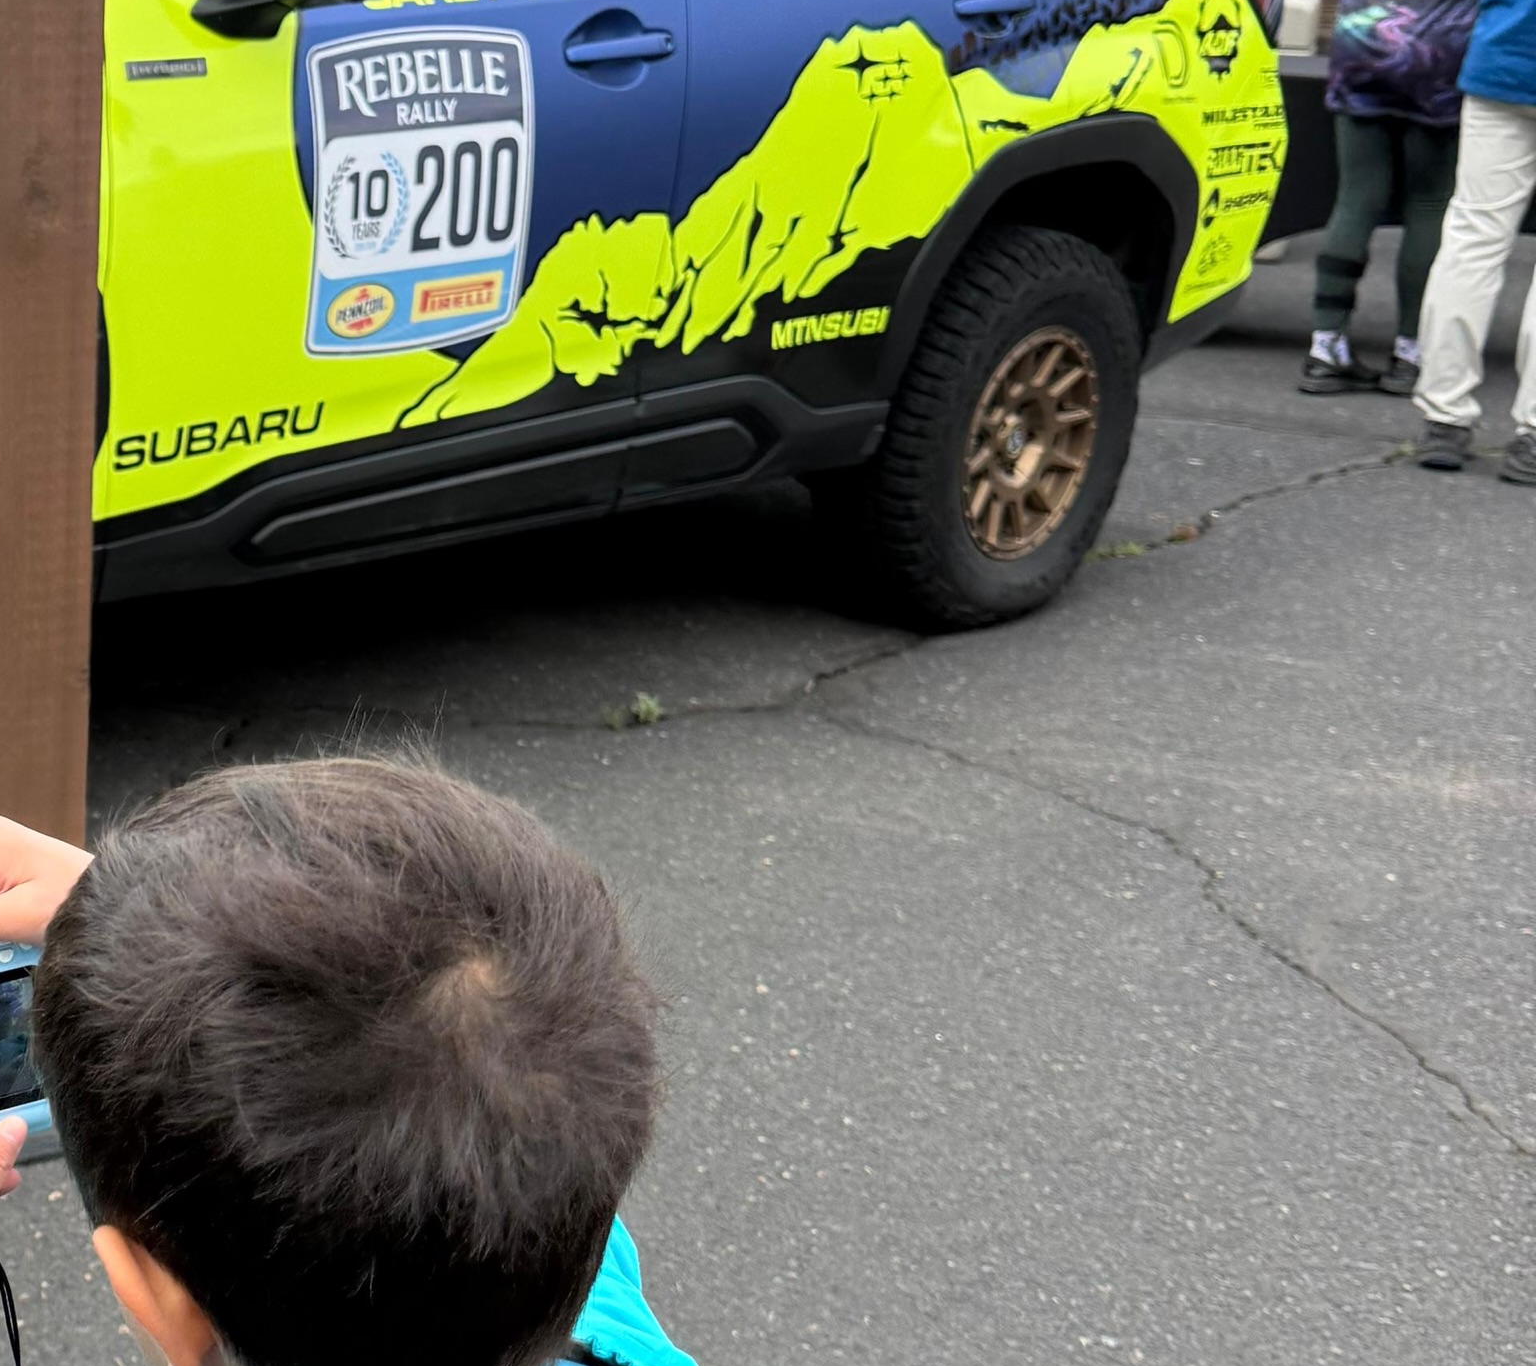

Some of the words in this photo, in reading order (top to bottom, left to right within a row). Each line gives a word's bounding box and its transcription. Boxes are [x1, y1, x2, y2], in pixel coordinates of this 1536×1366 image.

[334, 48, 510, 117] REBELLE
[396, 97, 458, 126] RALLY
[347, 169, 389, 220] 10
[411, 136, 519, 254] 200
[351, 221, 381, 240] YEARS
[335, 295, 388, 325] PENNZOIL
[419, 280, 495, 314] PIRELLI
[771, 305, 891, 350] MTNSUBI
[114, 401, 325, 471] SUBARU
